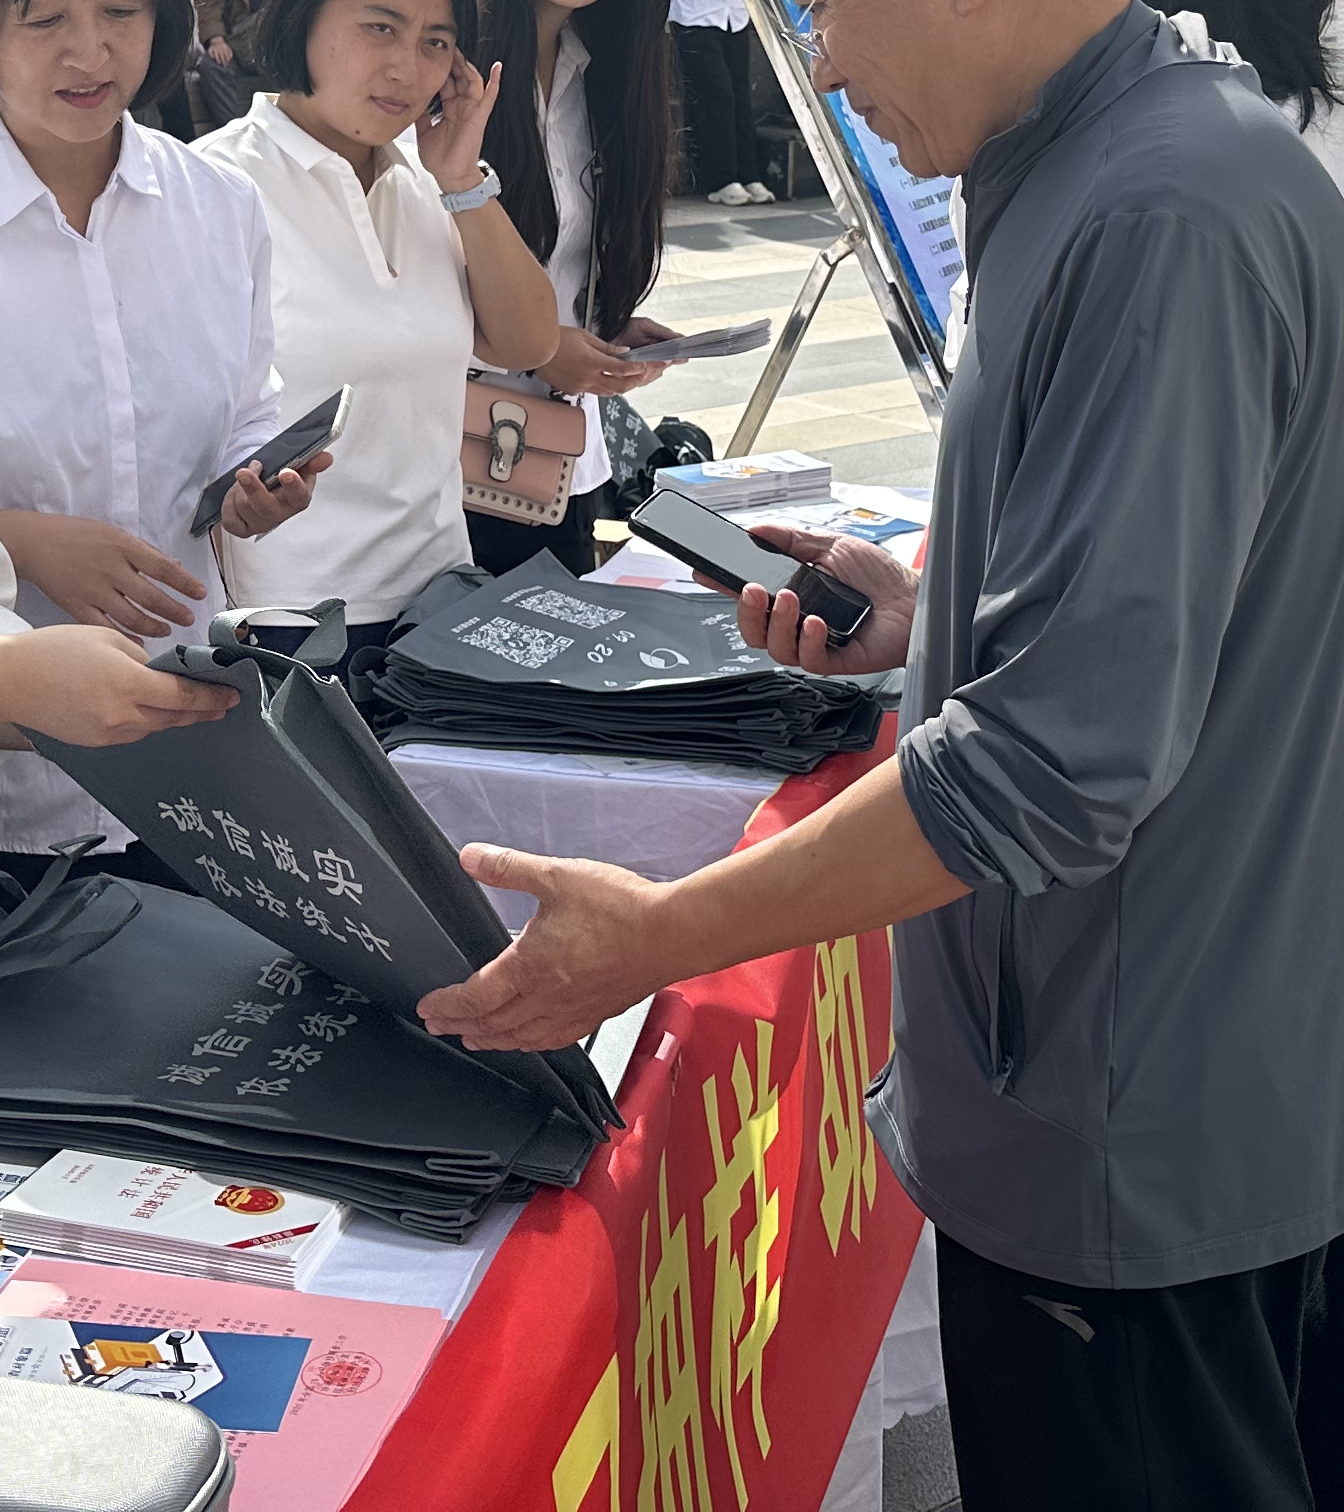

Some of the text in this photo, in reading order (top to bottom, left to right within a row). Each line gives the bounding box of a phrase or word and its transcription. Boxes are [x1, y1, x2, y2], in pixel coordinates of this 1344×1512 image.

[157, 796, 363, 906] 诚信诚实
[194, 854, 393, 962] 依法统计
[156, 957, 316, 1086] 诚信诚实
[236, 983, 371, 1097] 依法统计
